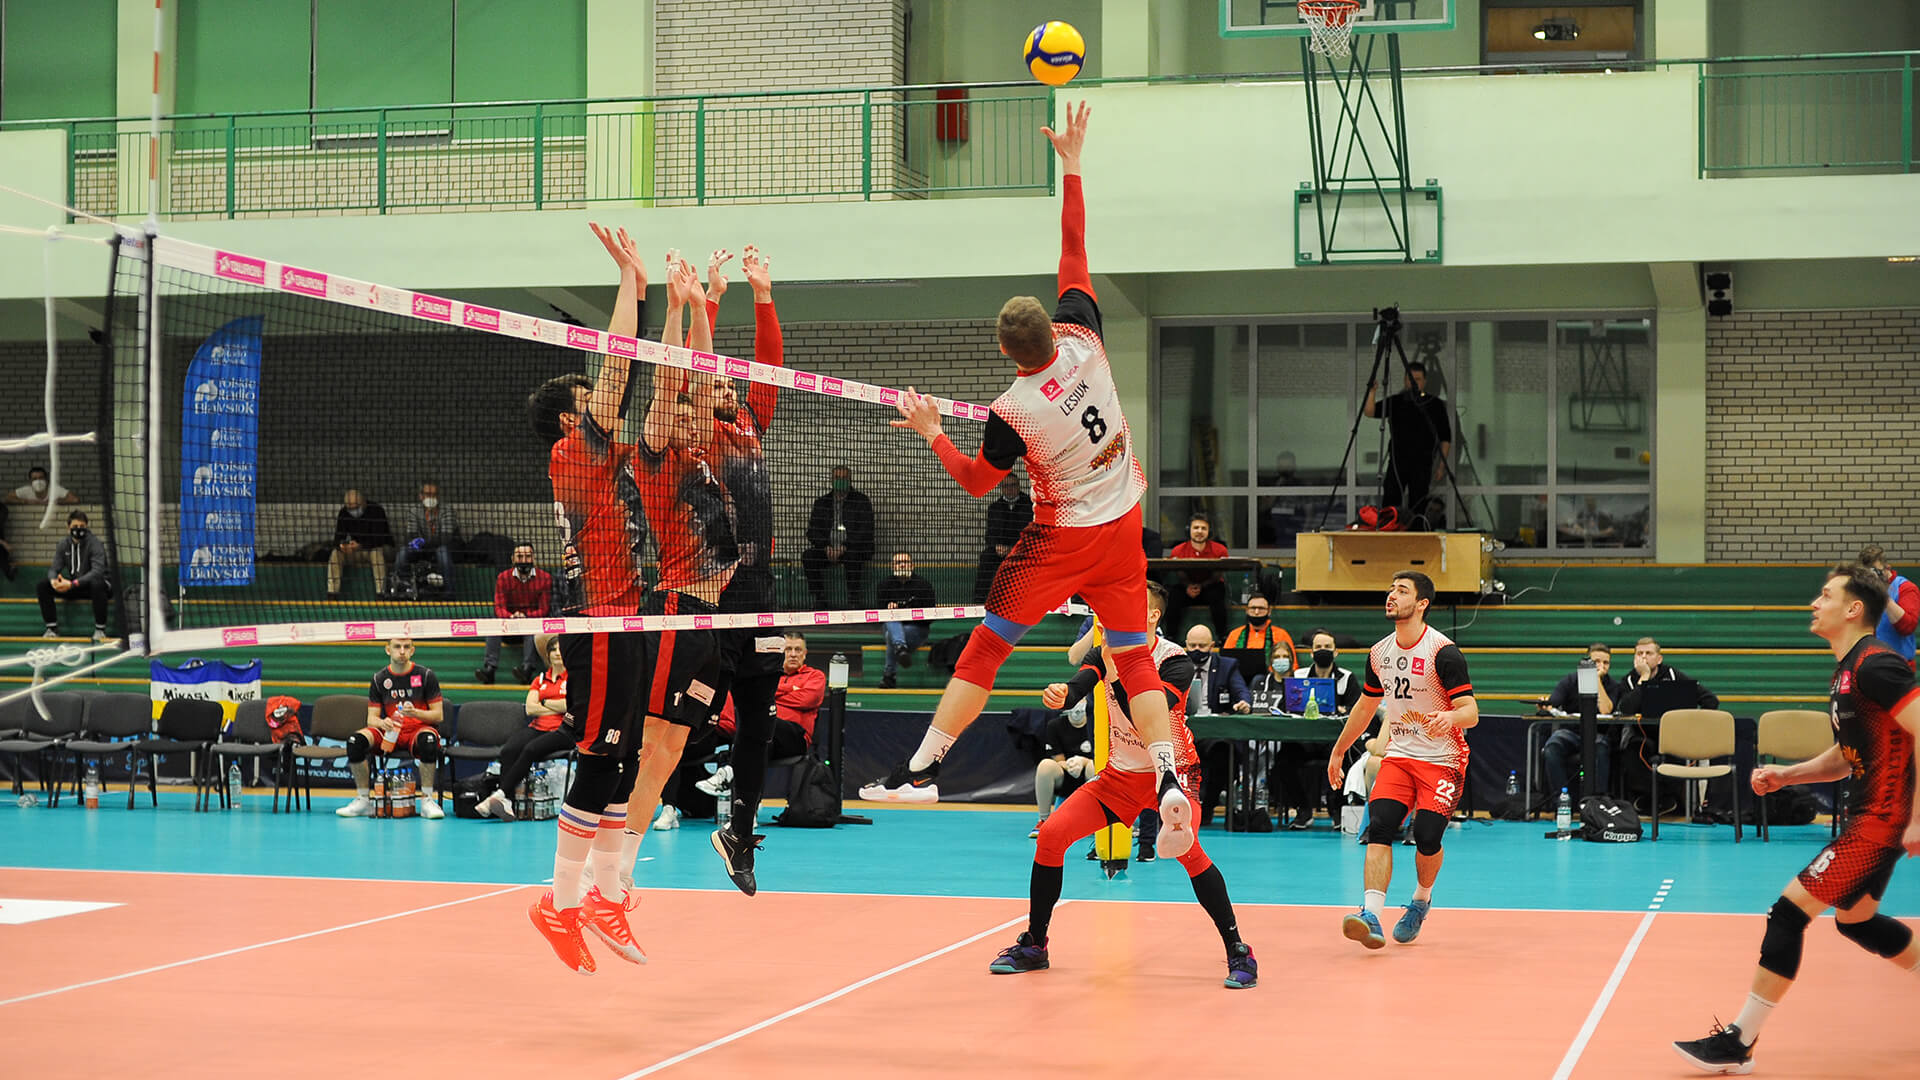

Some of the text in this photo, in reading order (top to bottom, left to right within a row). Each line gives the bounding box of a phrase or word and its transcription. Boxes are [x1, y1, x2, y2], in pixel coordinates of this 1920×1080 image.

[1060, 380, 1090, 416] LESIUK
[1081, 405, 1107, 444] 8
[1395, 676, 1413, 699] 22
[605, 729, 621, 745] 88
[1436, 779, 1455, 800] 22
[1603, 830, 1638, 842] Kappa
